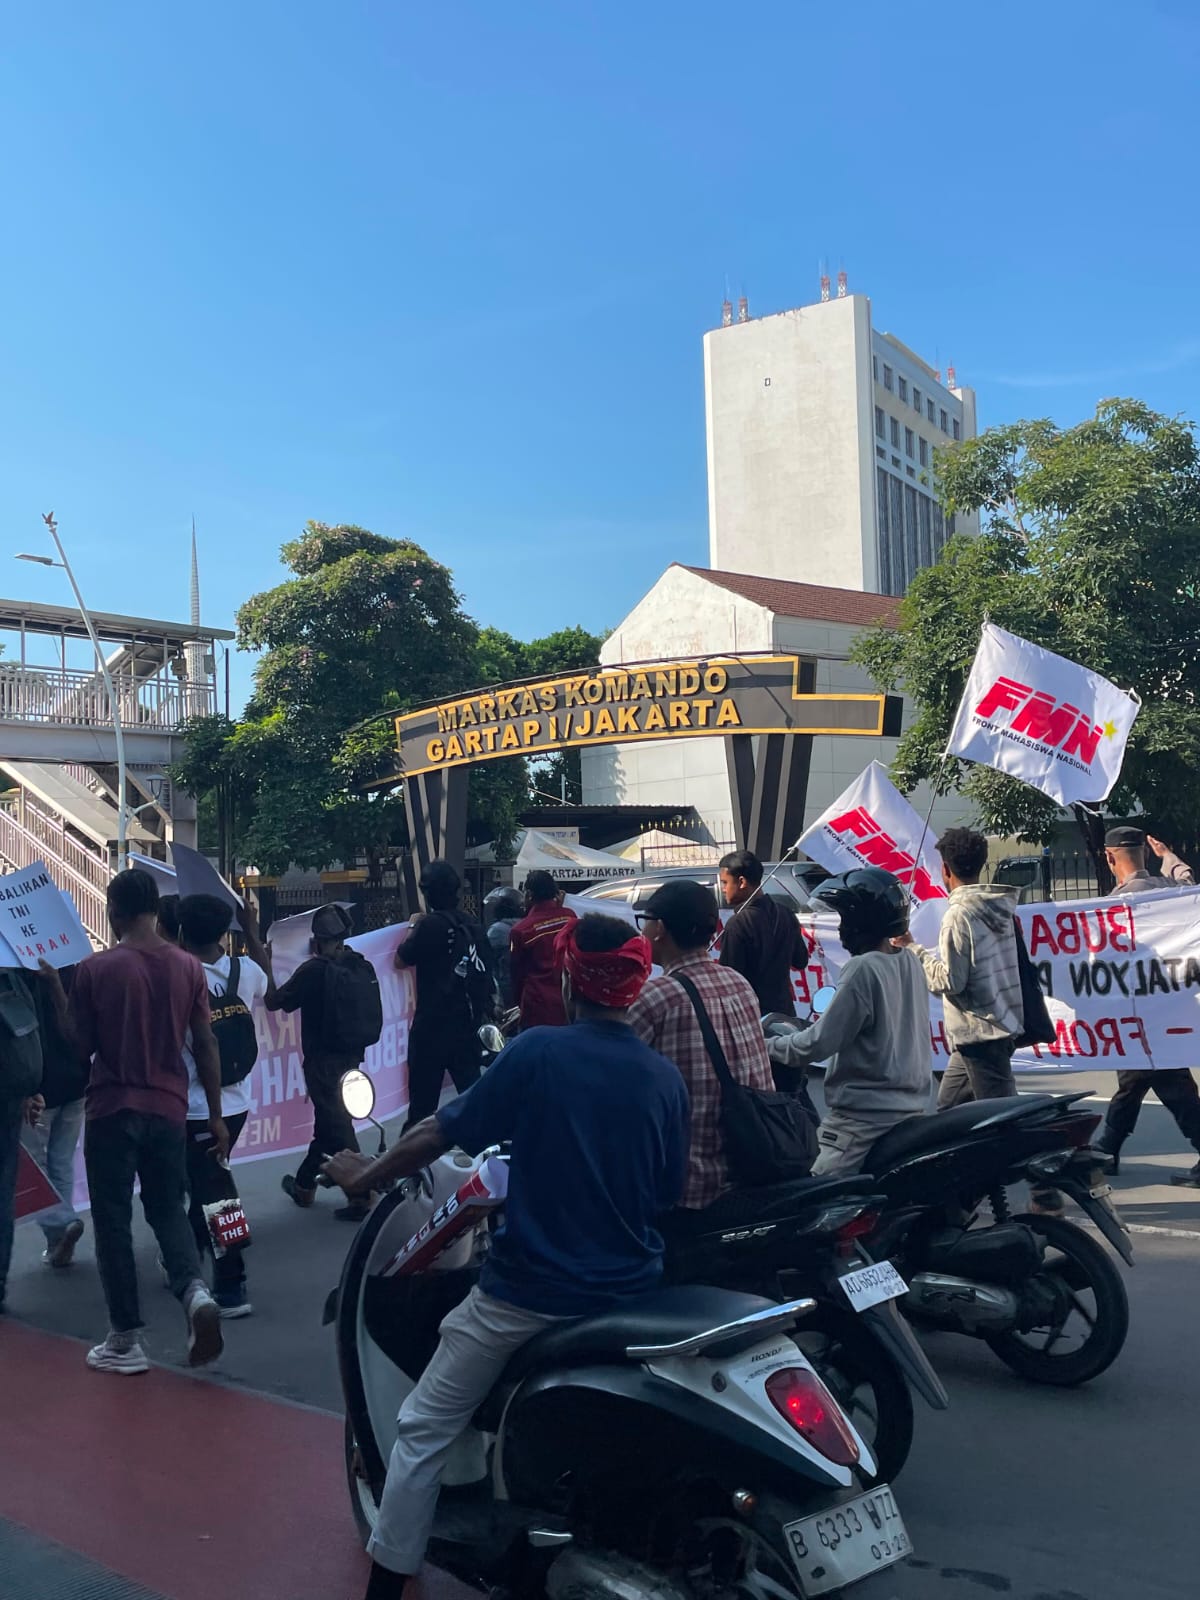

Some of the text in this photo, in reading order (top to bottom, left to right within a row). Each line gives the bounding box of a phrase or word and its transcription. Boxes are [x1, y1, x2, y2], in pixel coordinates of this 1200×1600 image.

[436, 665, 728, 733] MARKAS KOMANDO
[975, 675, 1104, 766] FMN
[426, 719, 540, 762] GARTAP
[973, 715, 1093, 777] FRONT MAHASISWA NASIONAL
[823, 825, 845, 847] FRONT
[8, 904, 31, 919] TNI
[20, 923, 38, 938] KE
[221, 1225, 245, 1241] THE
[790, 1530, 809, 1558] B
[816, 1507, 863, 1550] 6333
